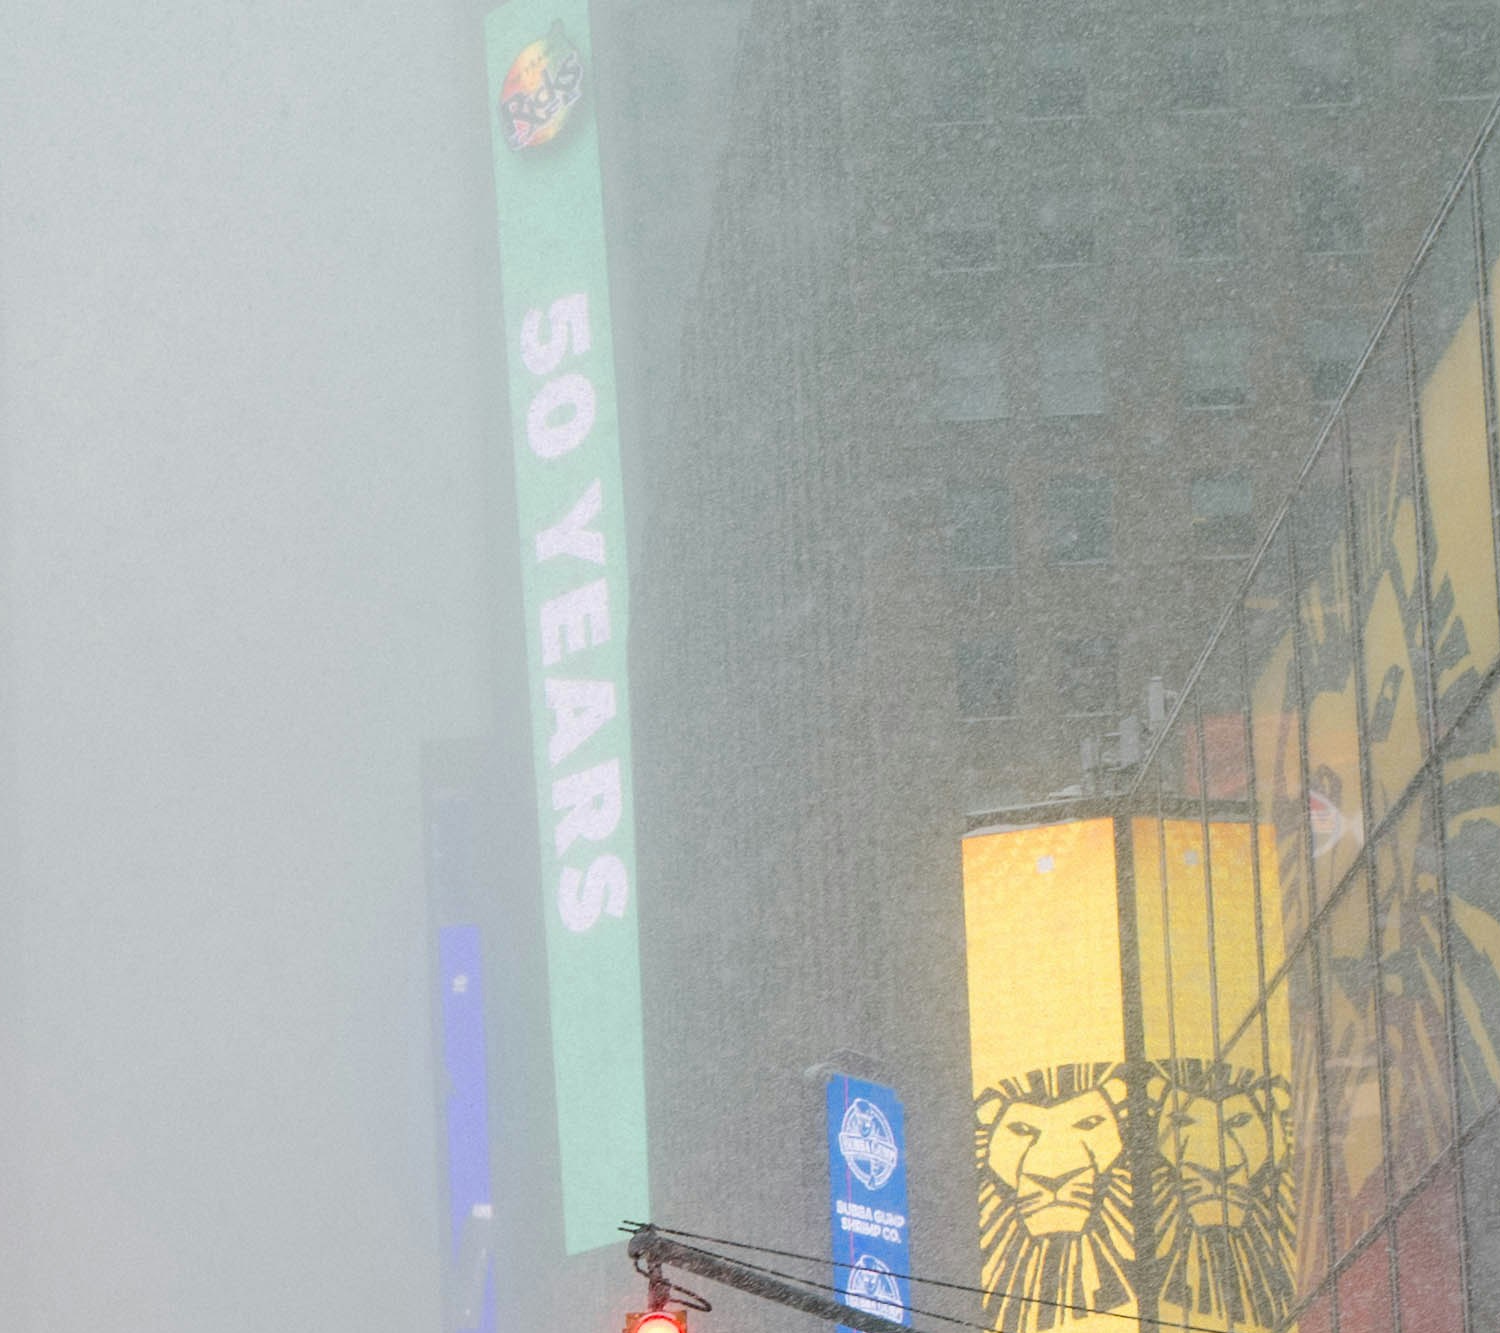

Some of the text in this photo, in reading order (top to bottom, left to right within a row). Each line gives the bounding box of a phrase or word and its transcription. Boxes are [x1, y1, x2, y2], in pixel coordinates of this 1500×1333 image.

[521, 293, 628, 932] 50 YEARS
[836, 1200, 906, 1228] BUBBA GUMP
[841, 1217, 902, 1244] SHRIMP CO.
